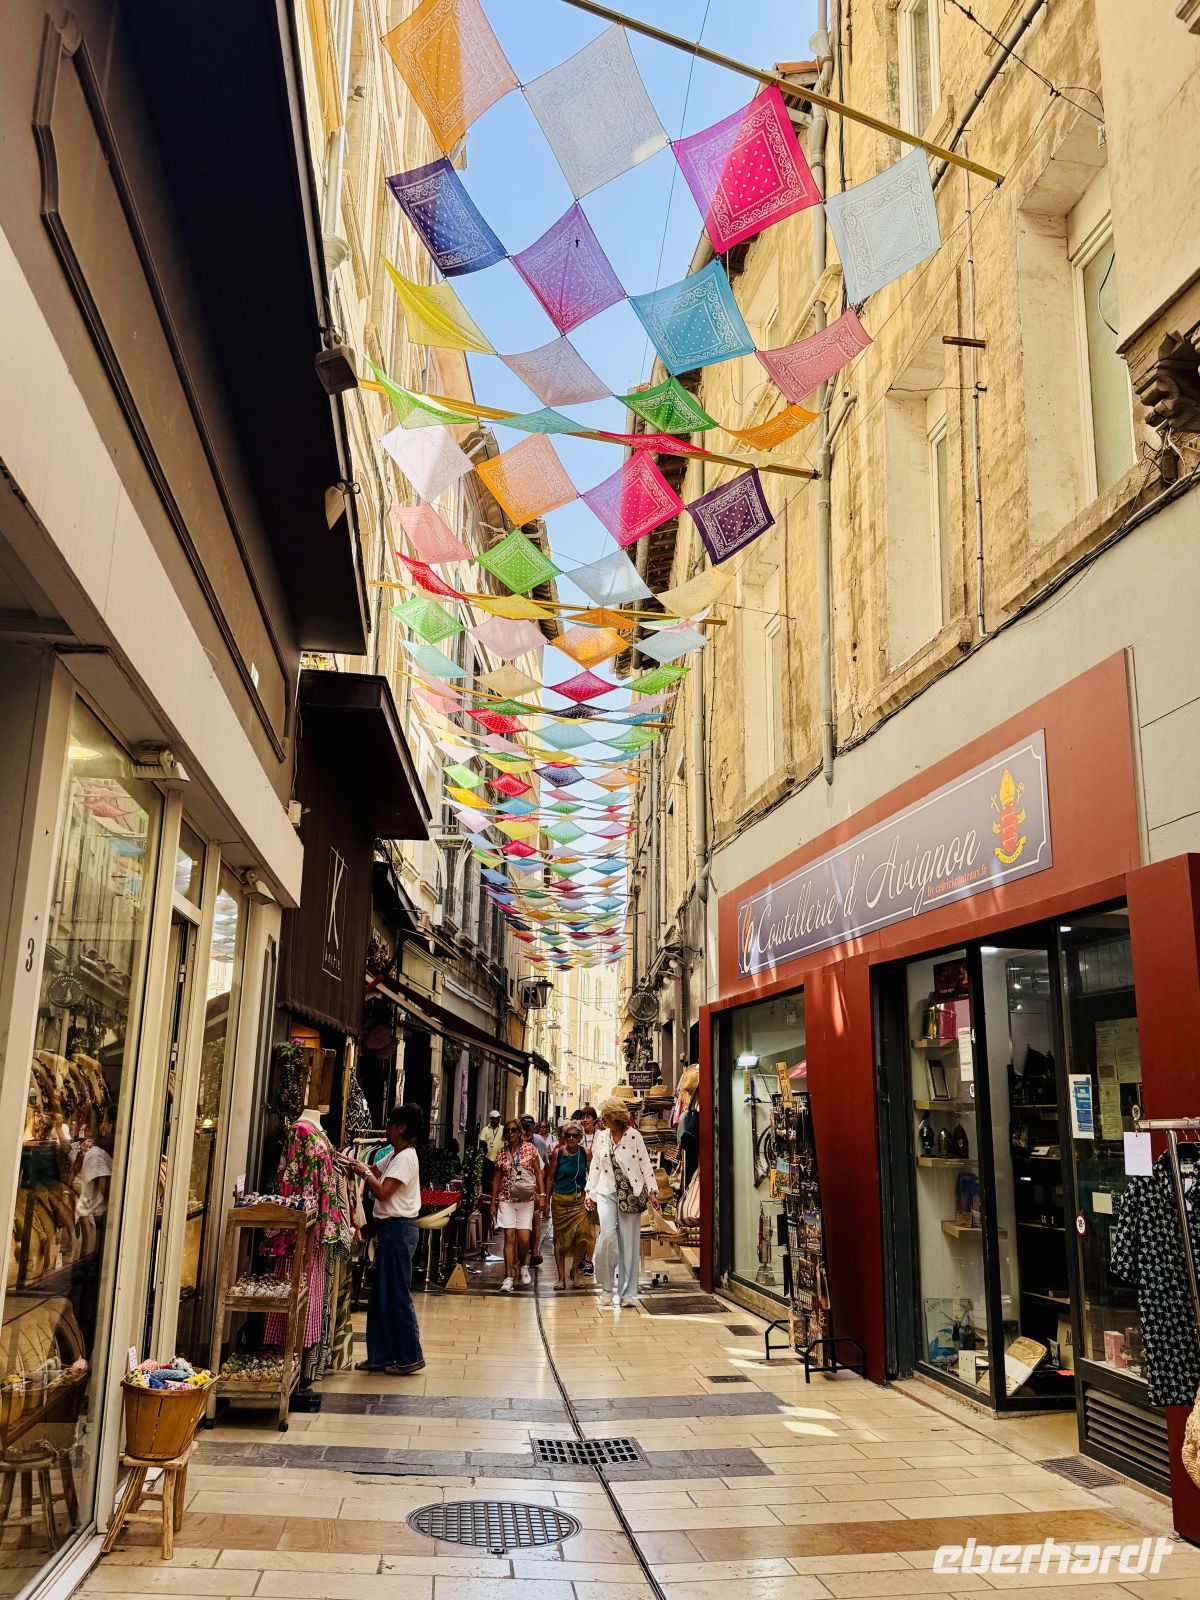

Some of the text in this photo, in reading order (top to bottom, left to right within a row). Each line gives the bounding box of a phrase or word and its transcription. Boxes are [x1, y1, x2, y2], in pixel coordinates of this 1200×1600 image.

[758, 880, 839, 954] Coutellerie
[865, 829, 982, 917] Avignon
[26, 937, 34, 972] 3
